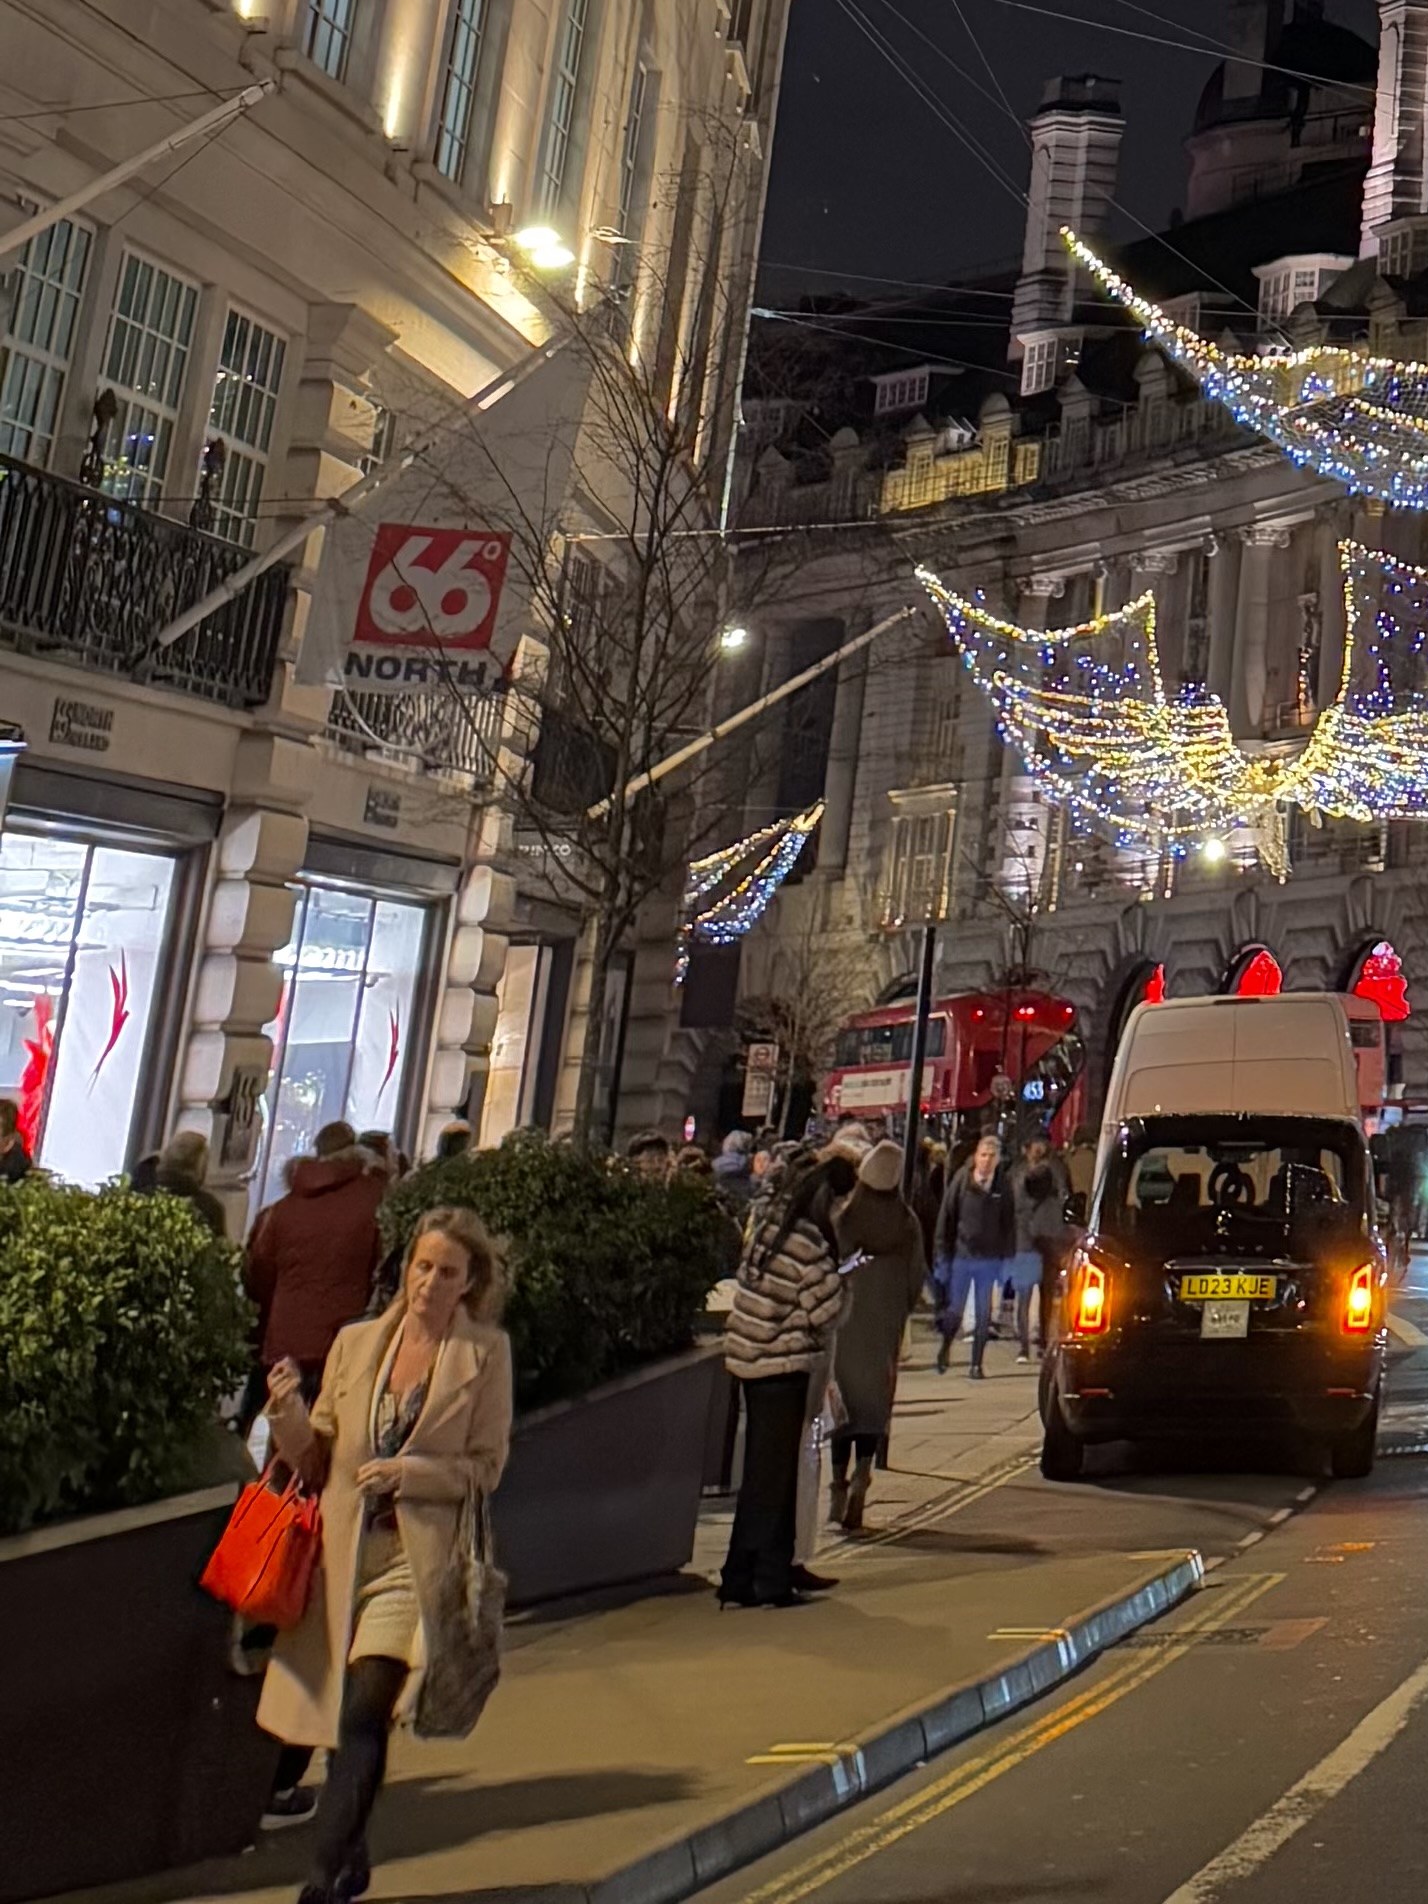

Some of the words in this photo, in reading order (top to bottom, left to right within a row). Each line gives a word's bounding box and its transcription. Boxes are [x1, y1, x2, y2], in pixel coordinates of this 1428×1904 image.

[344, 651, 488, 686] NORTH
[1187, 1277, 1232, 1295] LD23
[1236, 1277, 1272, 1295] KJE
